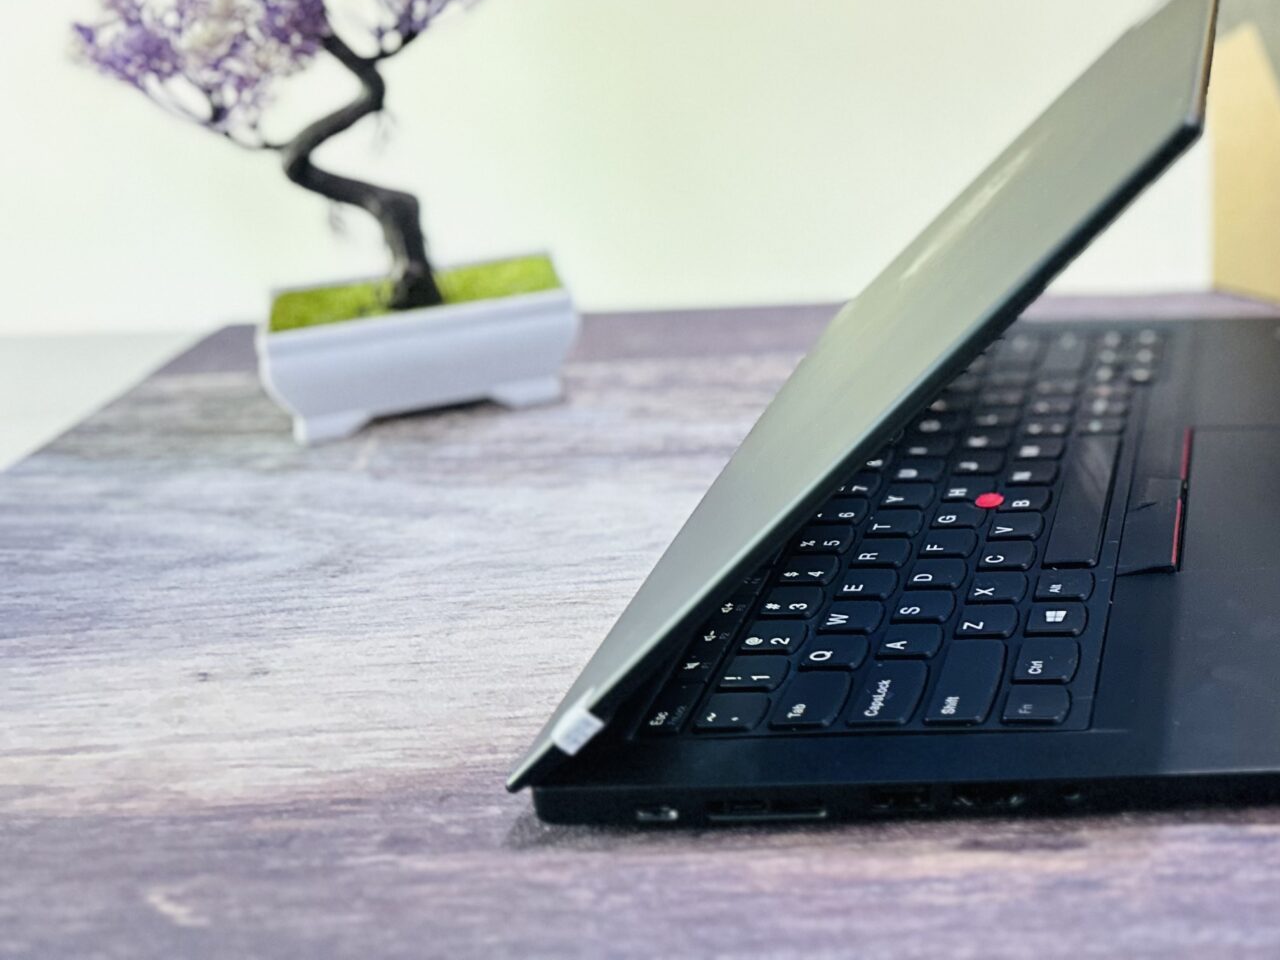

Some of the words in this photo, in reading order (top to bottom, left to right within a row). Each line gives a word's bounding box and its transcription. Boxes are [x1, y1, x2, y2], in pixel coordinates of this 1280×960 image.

[947, 488, 968, 497] H
[885, 495, 904, 503] Y
[1011, 499, 1030, 508] B
[937, 515, 957, 523] G
[872, 523, 891, 531] T
[994, 526, 1014, 534] V
[857, 552, 879, 560] R
[984, 555, 1005, 563] C
[913, 573, 933, 582] D
[842, 584, 864, 592] E
[973, 587, 995, 596] X
[788, 602, 808, 610] 3
[900, 606, 920, 615] S
[826, 613, 849, 626] W
[962, 621, 984, 630] Z
[770, 637, 790, 645] 2
[885, 640, 907, 650] A
[809, 650, 833, 661] Q
[1027, 660, 1044, 675] Ctrl
[940, 696, 960, 715] Shift
[1018, 704, 1033, 714] Fn
[787, 703, 806, 718] Tab
